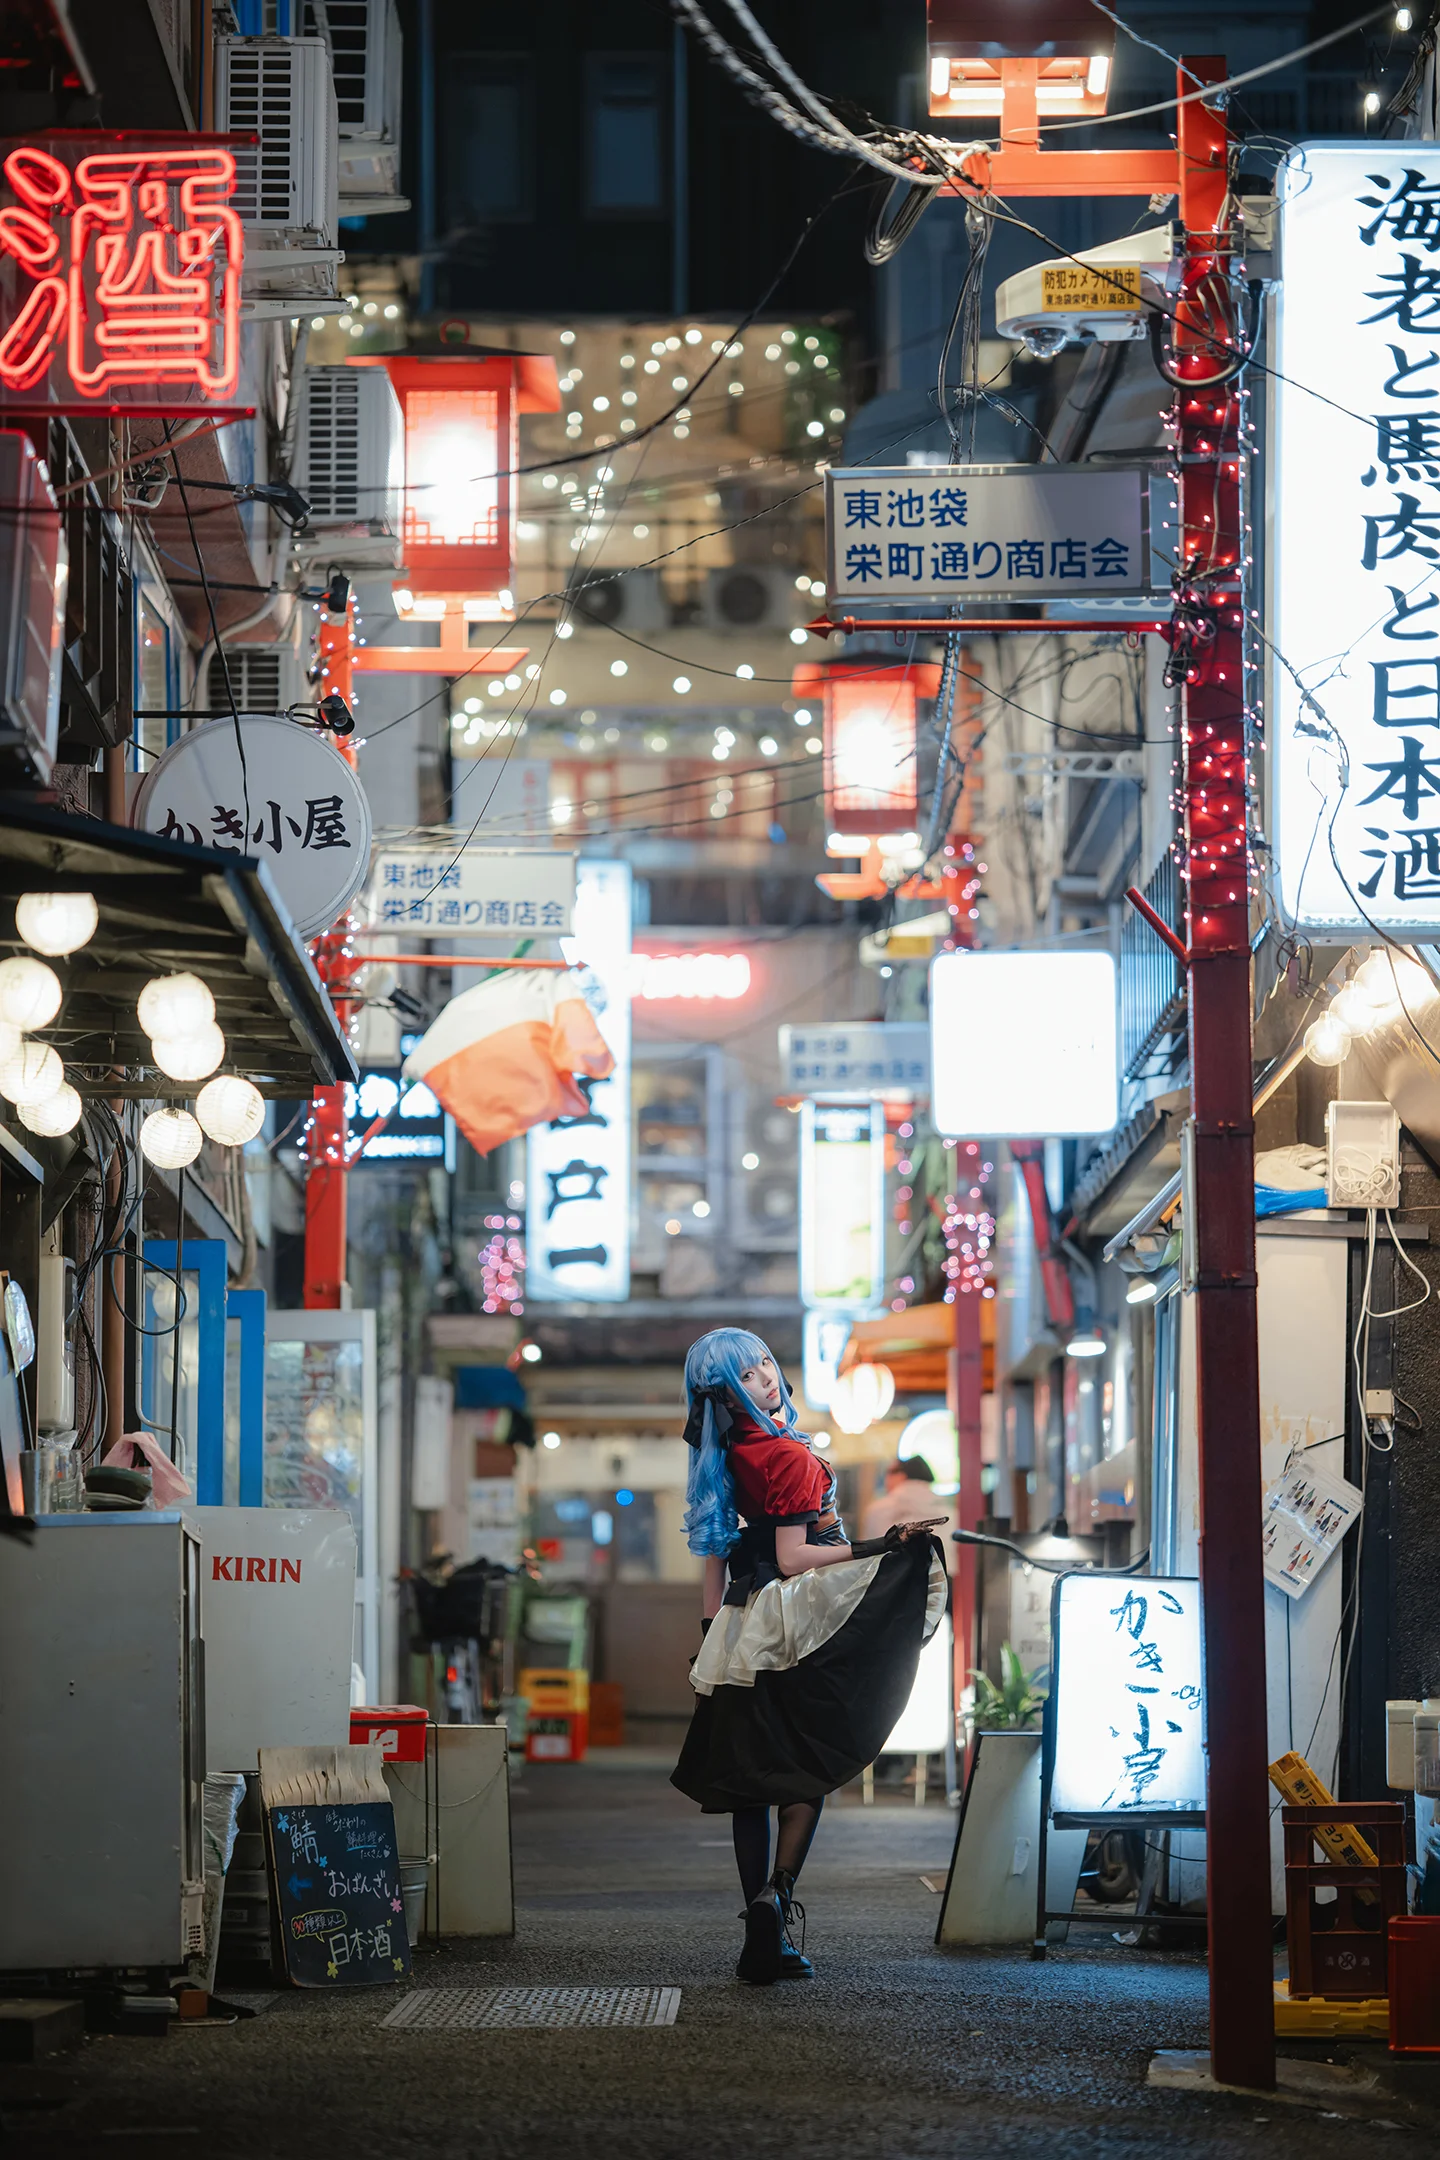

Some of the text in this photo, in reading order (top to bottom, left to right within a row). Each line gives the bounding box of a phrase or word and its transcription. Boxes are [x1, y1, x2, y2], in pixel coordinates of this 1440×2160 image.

[0, 147, 243, 391] 酒
[1044, 270, 1136, 290] 防犯カメラ作動中
[1045, 292, 1136, 306] 東池袋栄町通り商店会
[843, 487, 968, 529] 東池袋
[1354, 168, 1440, 901] 海老と馬肉と日本酒
[845, 537, 1130, 583] 栄町通り商店会
[155, 795, 352, 855] かき小屋
[382, 864, 462, 889] 東池袋
[382, 898, 565, 927] 栄町通り商店会
[211, 1555, 302, 1584] KIRIN
[1101, 1589, 1184, 1809] かき小屋
[289, 1819, 319, 1864] 鯖
[328, 1869, 399, 1899] おばんざい
[329, 1924, 392, 1966] 日本酒
